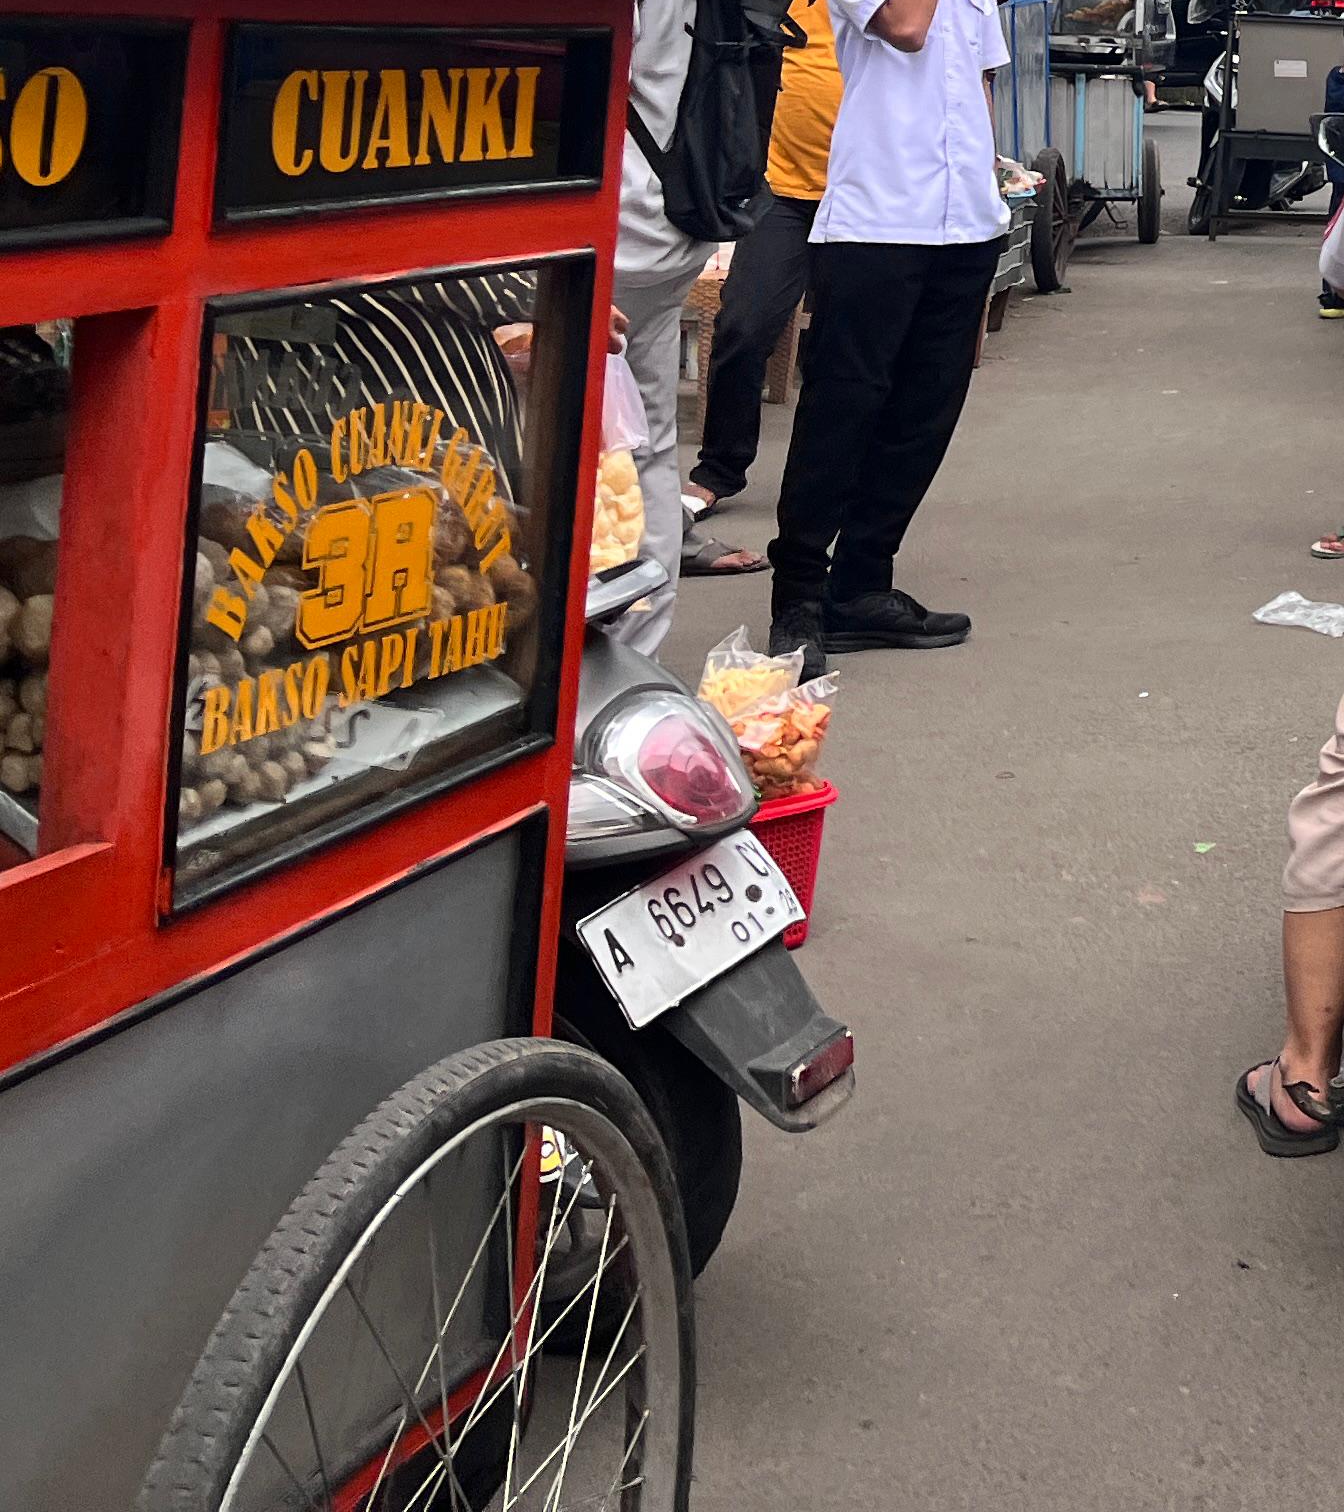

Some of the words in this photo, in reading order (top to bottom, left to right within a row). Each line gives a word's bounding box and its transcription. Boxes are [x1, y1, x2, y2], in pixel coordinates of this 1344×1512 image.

[0, 66, 88, 187] O
[271, 66, 541, 177] CUANKI
[206, 448, 318, 643] BAKSO
[330, 400, 445, 485] CUANKI
[200, 655, 330, 756] BAKSO
[340, 626, 418, 708] SAPI
[428, 601, 508, 680] TAHU
[603, 927, 635, 974] A
[648, 863, 734, 941] 6649
